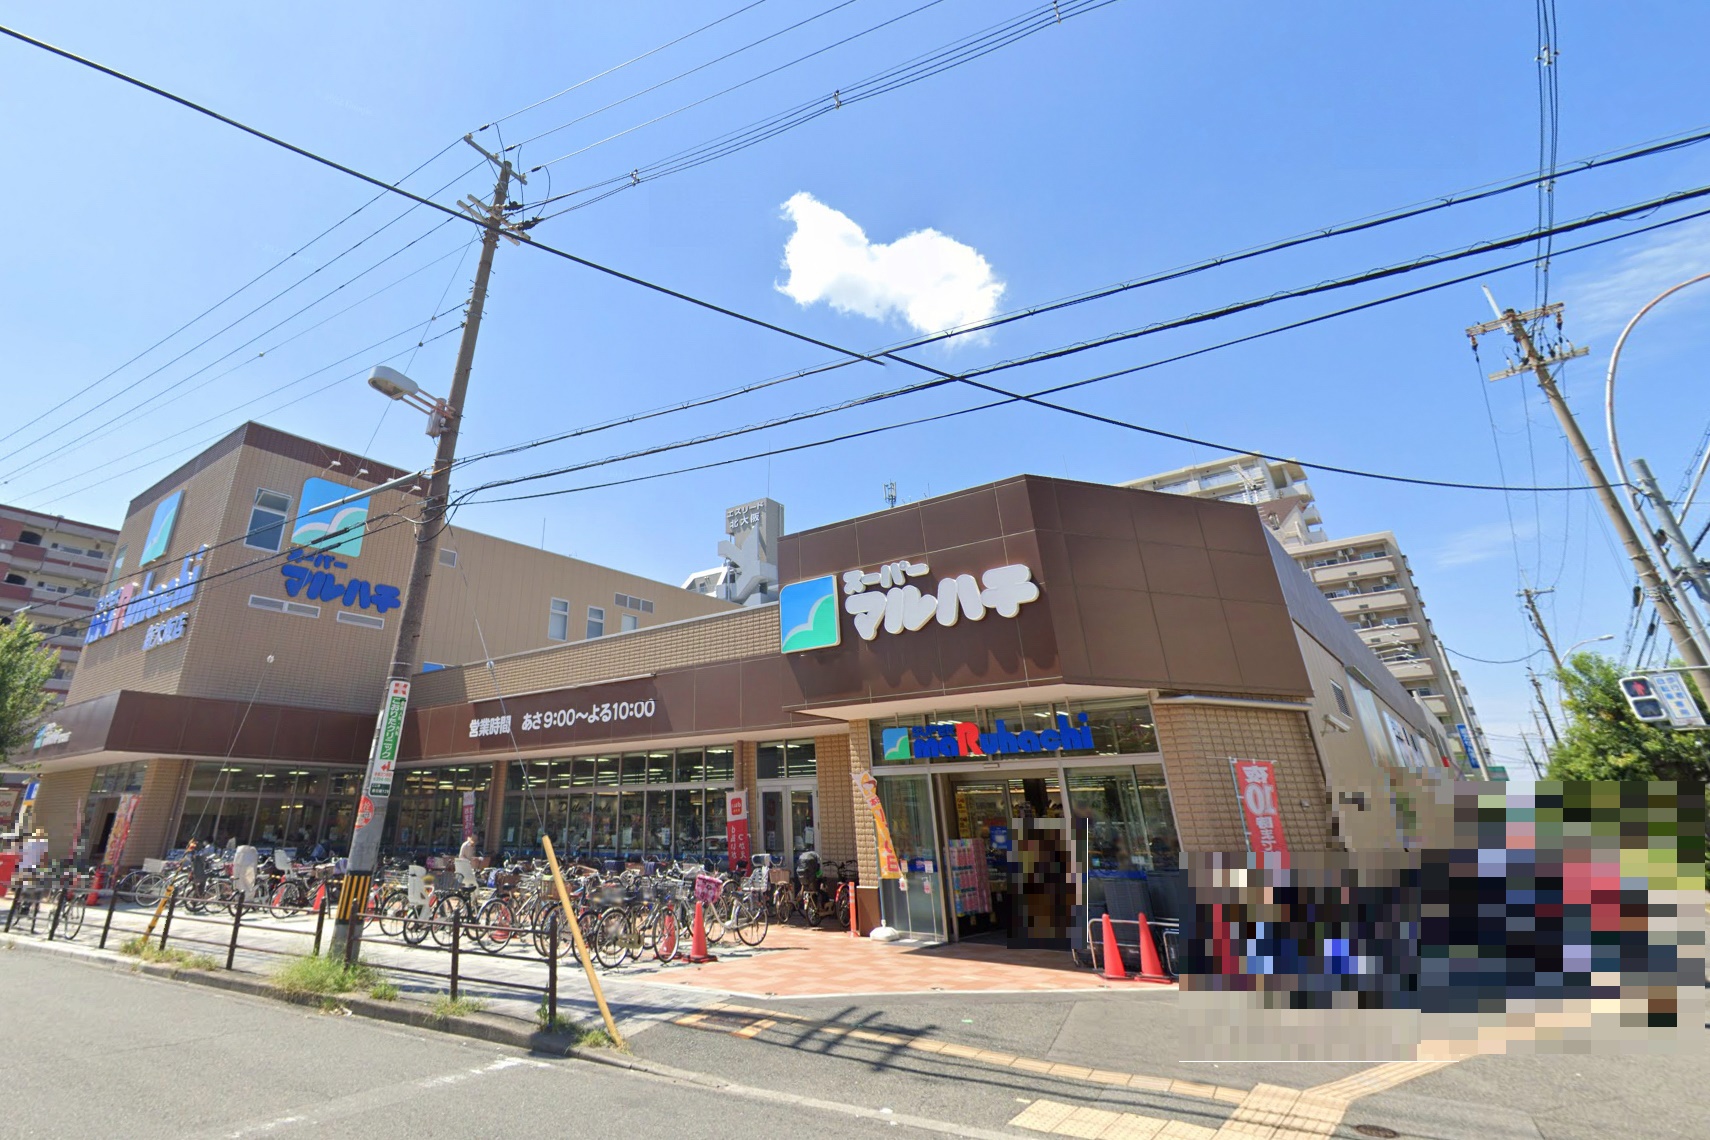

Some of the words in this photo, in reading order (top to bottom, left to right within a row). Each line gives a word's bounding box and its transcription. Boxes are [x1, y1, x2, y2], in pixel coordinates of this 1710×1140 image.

[727, 502, 765, 518] エスリード
[730, 512, 760, 529] 北大阪
[287, 547, 348, 570] スーパー
[281, 564, 401, 614] マルハチ
[843, 560, 930, 595] スーパー
[845, 564, 1040, 641] マルハチ
[381, 697, 402, 759] こおりたクリニック
[469, 715, 512, 738] 営業時間
